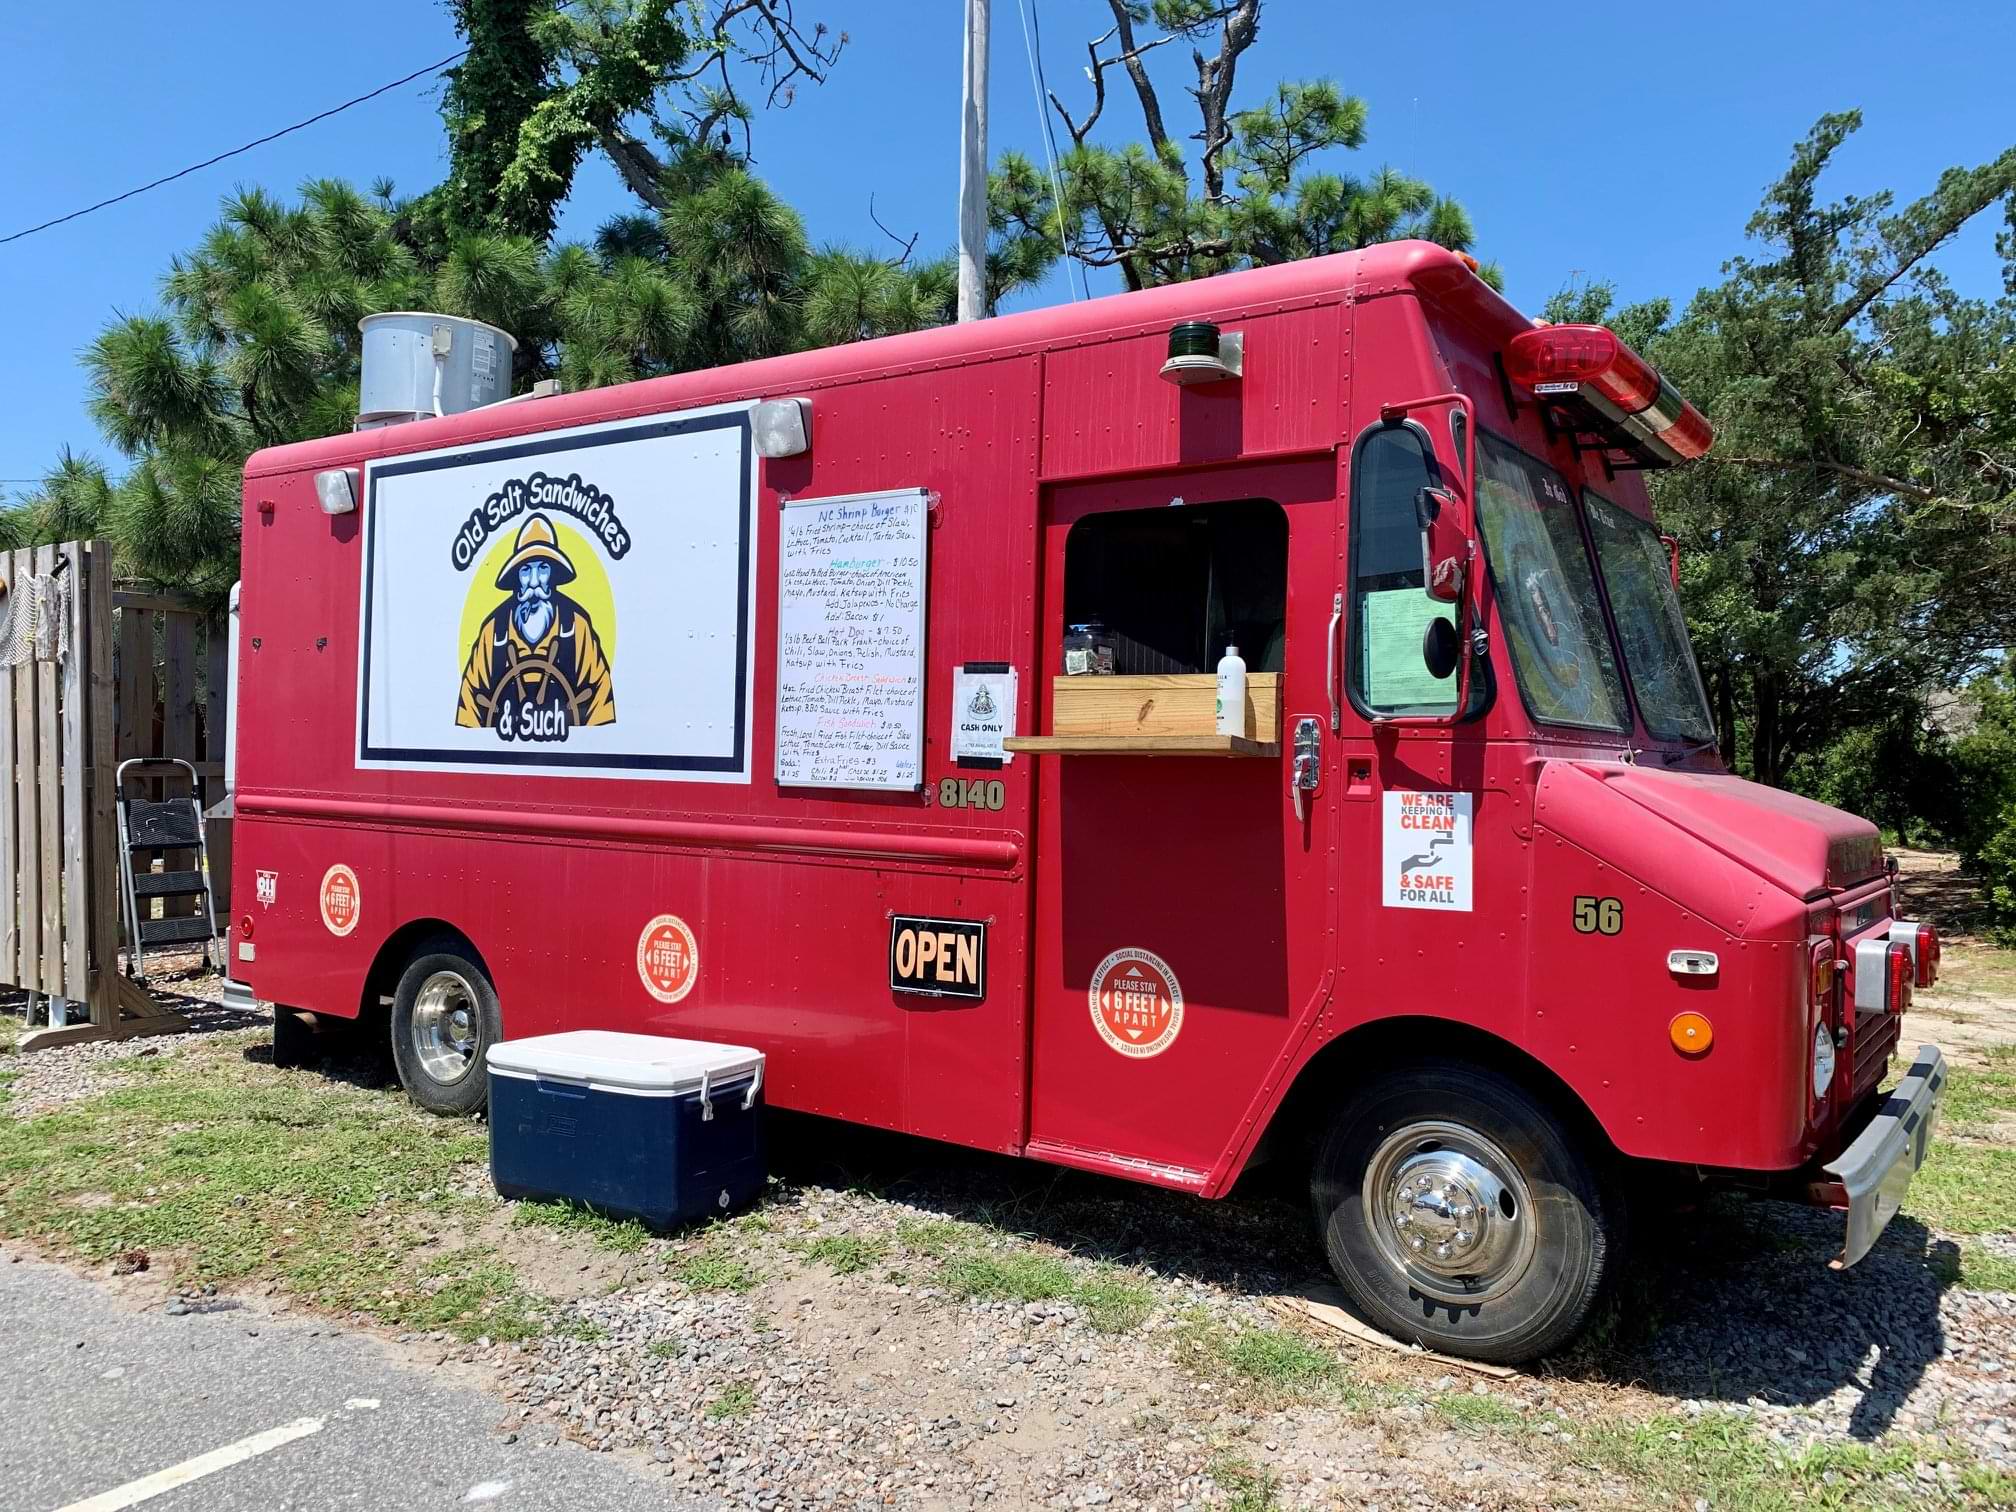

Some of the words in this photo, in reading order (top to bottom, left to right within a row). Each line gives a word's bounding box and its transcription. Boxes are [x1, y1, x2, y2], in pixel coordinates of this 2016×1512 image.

[819, 510, 833, 522] NC
[837, 506, 867, 523] Shrimp
[871, 503, 900, 520] Burger
[453, 513, 487, 567] Old
[488, 484, 524, 526] Salt
[528, 476, 629, 554] Sandwiches
[806, 524, 820, 535] Fried
[876, 517, 886, 528] of
[788, 547, 806, 557] with
[810, 546, 831, 555] Fries
[831, 558, 882, 571] Hamburger
[868, 586, 886, 597] with
[890, 588, 910, 598] Fries
[825, 599, 839, 608] Add
[885, 599, 895, 608] No
[896, 599, 918, 612] Charge
[844, 611, 869, 621] Bacon
[828, 626, 845, 636] Hot
[848, 626, 865, 638] Dog
[802, 633, 817, 644] Beef
[831, 636, 848, 646] Park
[901, 634, 910, 645] of
[786, 658, 812, 670] Katsup
[816, 659, 836, 668] with
[839, 659, 864, 671] Fries
[799, 682, 814, 694] Fried
[816, 685, 840, 694] Chicken
[840, 684, 864, 694] Breast
[908, 687, 917, 696] of
[820, 704, 840, 714] Sauce
[863, 707, 884, 717] Fries
[500, 699, 515, 736] &
[520, 699, 567, 737] Such
[817, 716, 835, 728] Fish
[818, 729, 833, 739] Fried
[960, 723, 980, 732] CASH
[982, 724, 1004, 733] ONLY
[889, 741, 910, 750] Sauce
[815, 755, 836, 765] Extra
[838, 755, 859, 767] Fries
[940, 777, 1006, 811] 8140
[1401, 794, 1424, 806] WE
[1425, 794, 1454, 807] ARE
[1401, 806, 1443, 815] KEEPING
[1445, 807, 1454, 816] IT
[1401, 815, 1454, 829] CLEAN
[1400, 874, 1410, 888] &
[1414, 875, 1454, 890] SAFE
[1400, 889, 1426, 902] FOR
[1429, 890, 1454, 903] ALL
[1573, 895, 1623, 936] 56
[654, 950, 660, 965] 6
[661, 950, 682, 968] FEET
[896, 928, 978, 984] OPEN
[653, 966, 680, 978] APART
[1096, 960, 1111, 980] EFFECT
[1116, 951, 1134, 960] SOCIAL
[1135, 951, 1163, 972] DISTANCING
[1167, 975, 1180, 998] EFFECT
[1114, 979, 1139, 991] PLEASE
[1140, 981, 1157, 993] STAY
[1114, 991, 1122, 1010] 6
[1126, 992, 1157, 1014] FEET
[1114, 1012, 1157, 1027] APART
